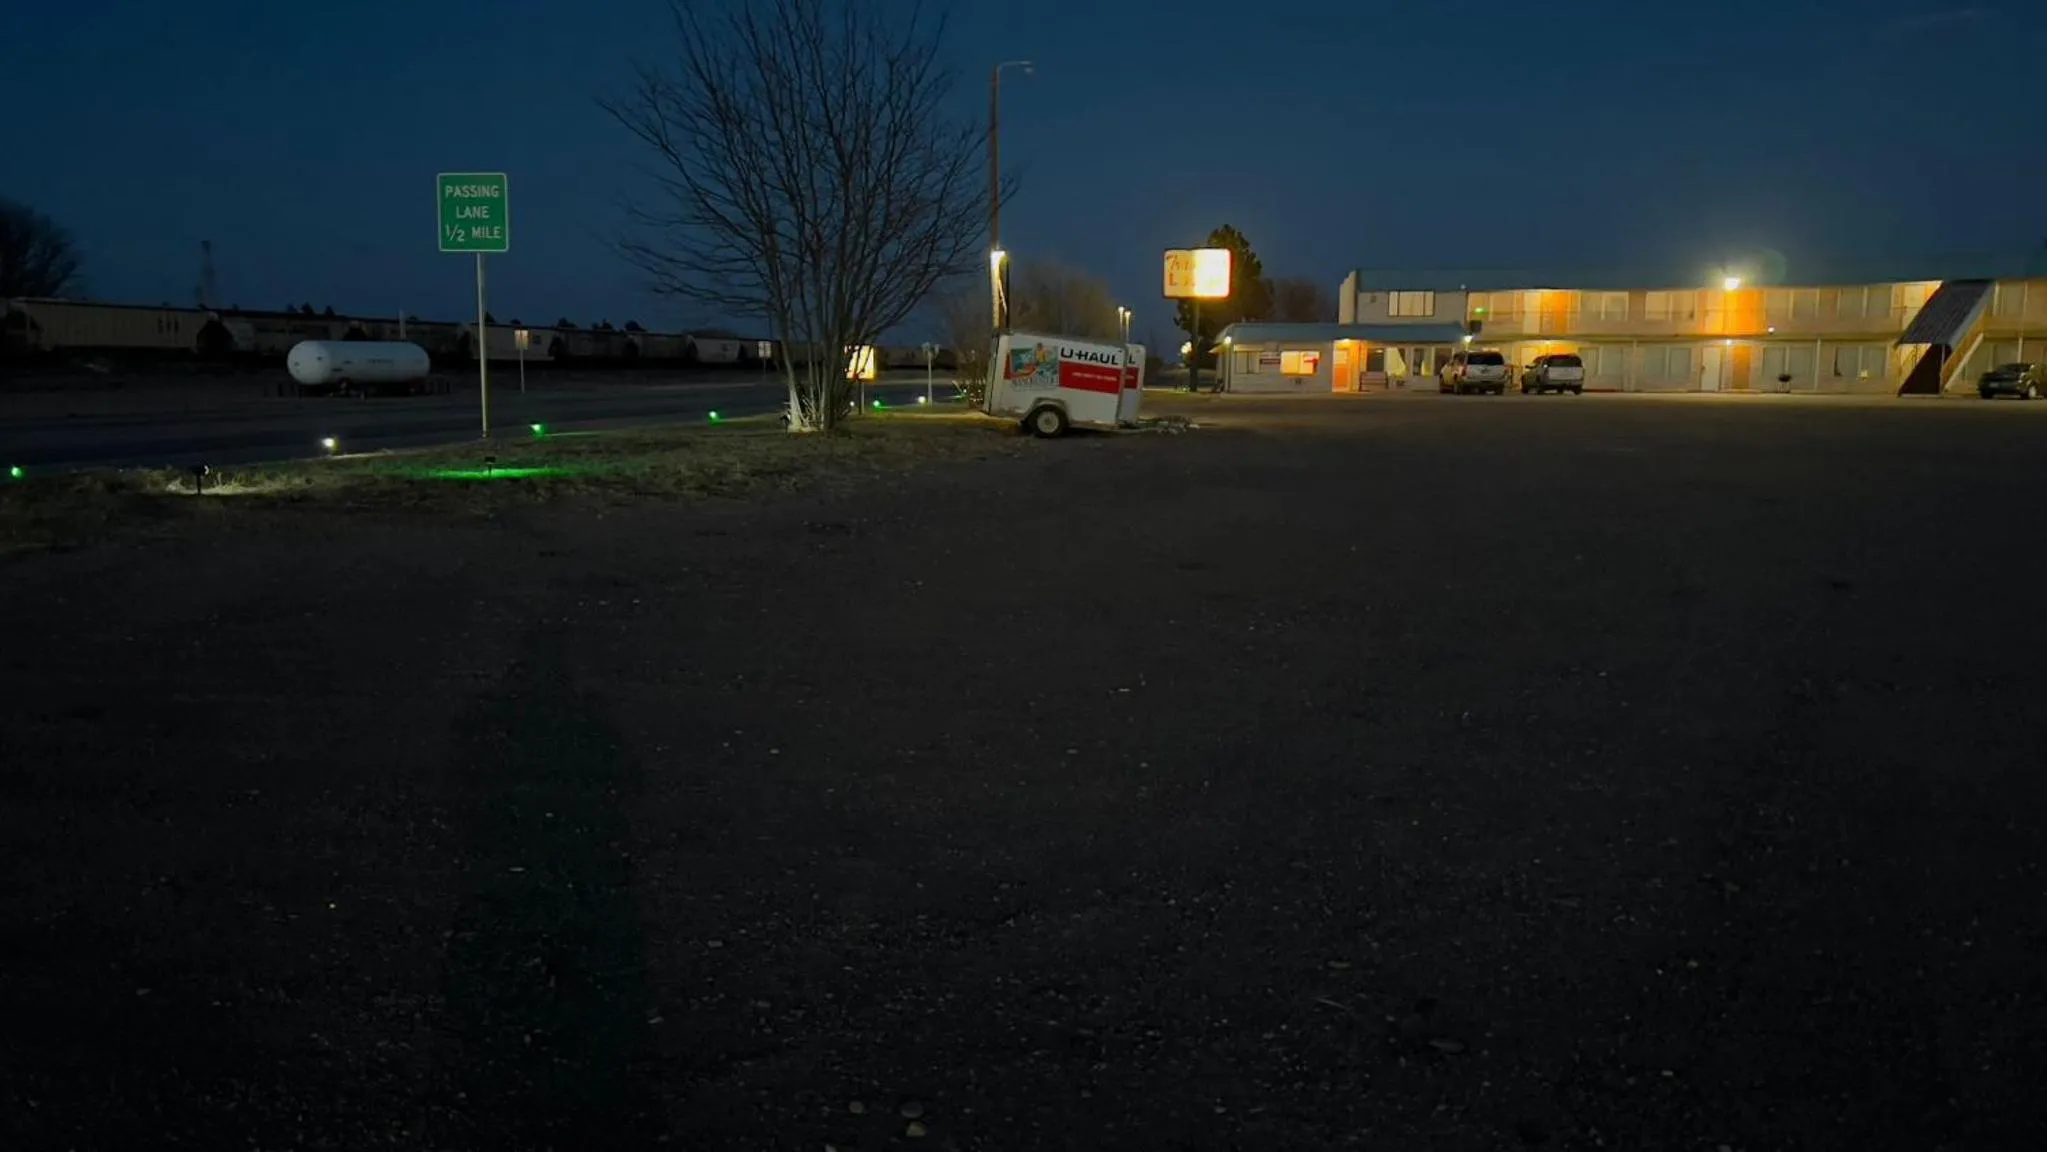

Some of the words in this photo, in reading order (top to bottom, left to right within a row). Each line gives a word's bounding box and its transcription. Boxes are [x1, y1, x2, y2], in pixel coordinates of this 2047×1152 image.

[445, 185, 500, 198] PASSING
[456, 205, 490, 219] LANE
[471, 225, 502, 239] MILE
[1060, 347, 1119, 365] U-HAUL
